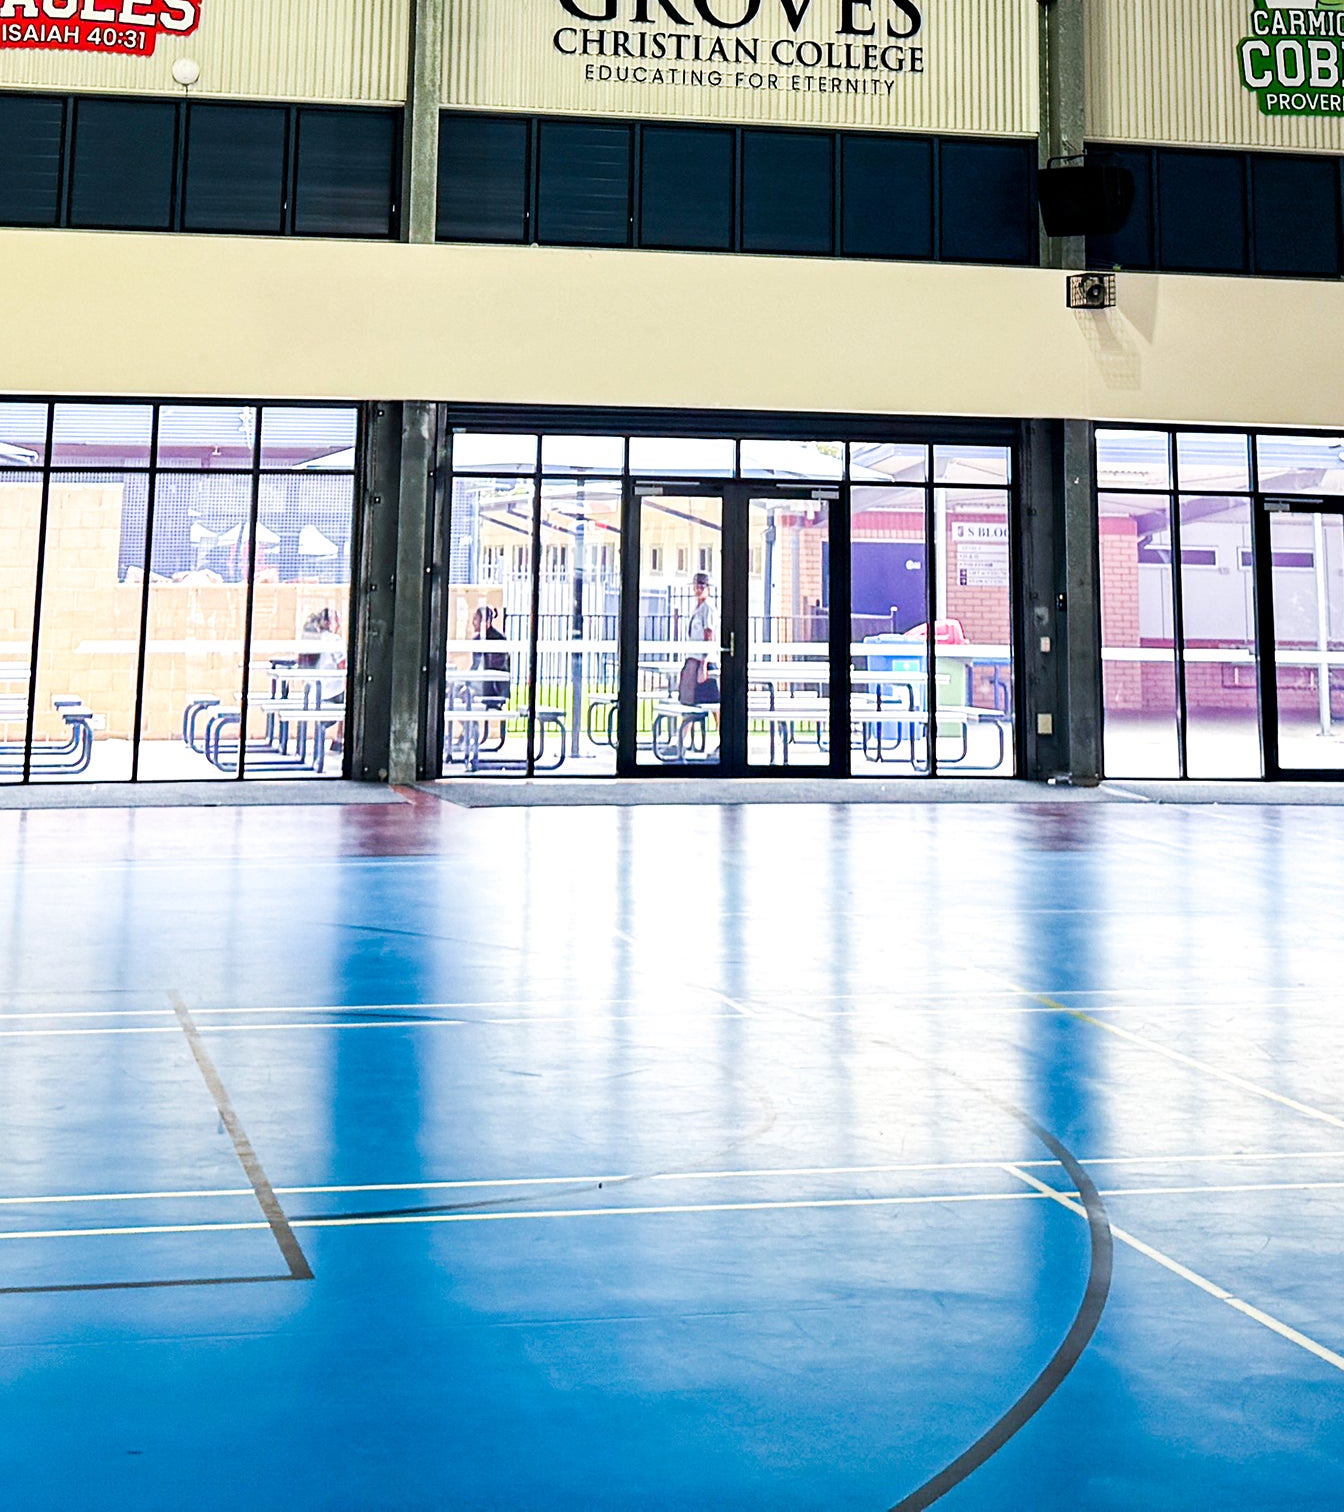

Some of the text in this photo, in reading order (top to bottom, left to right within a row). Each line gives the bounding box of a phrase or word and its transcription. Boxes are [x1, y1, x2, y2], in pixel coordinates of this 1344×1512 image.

[2, 24, 146, 50] ISAIAH 40:31
[553, 27, 924, 72] CHRISTIAN COLLEGE
[585, 64, 896, 96] EDUCATING FOR ETERNITY
